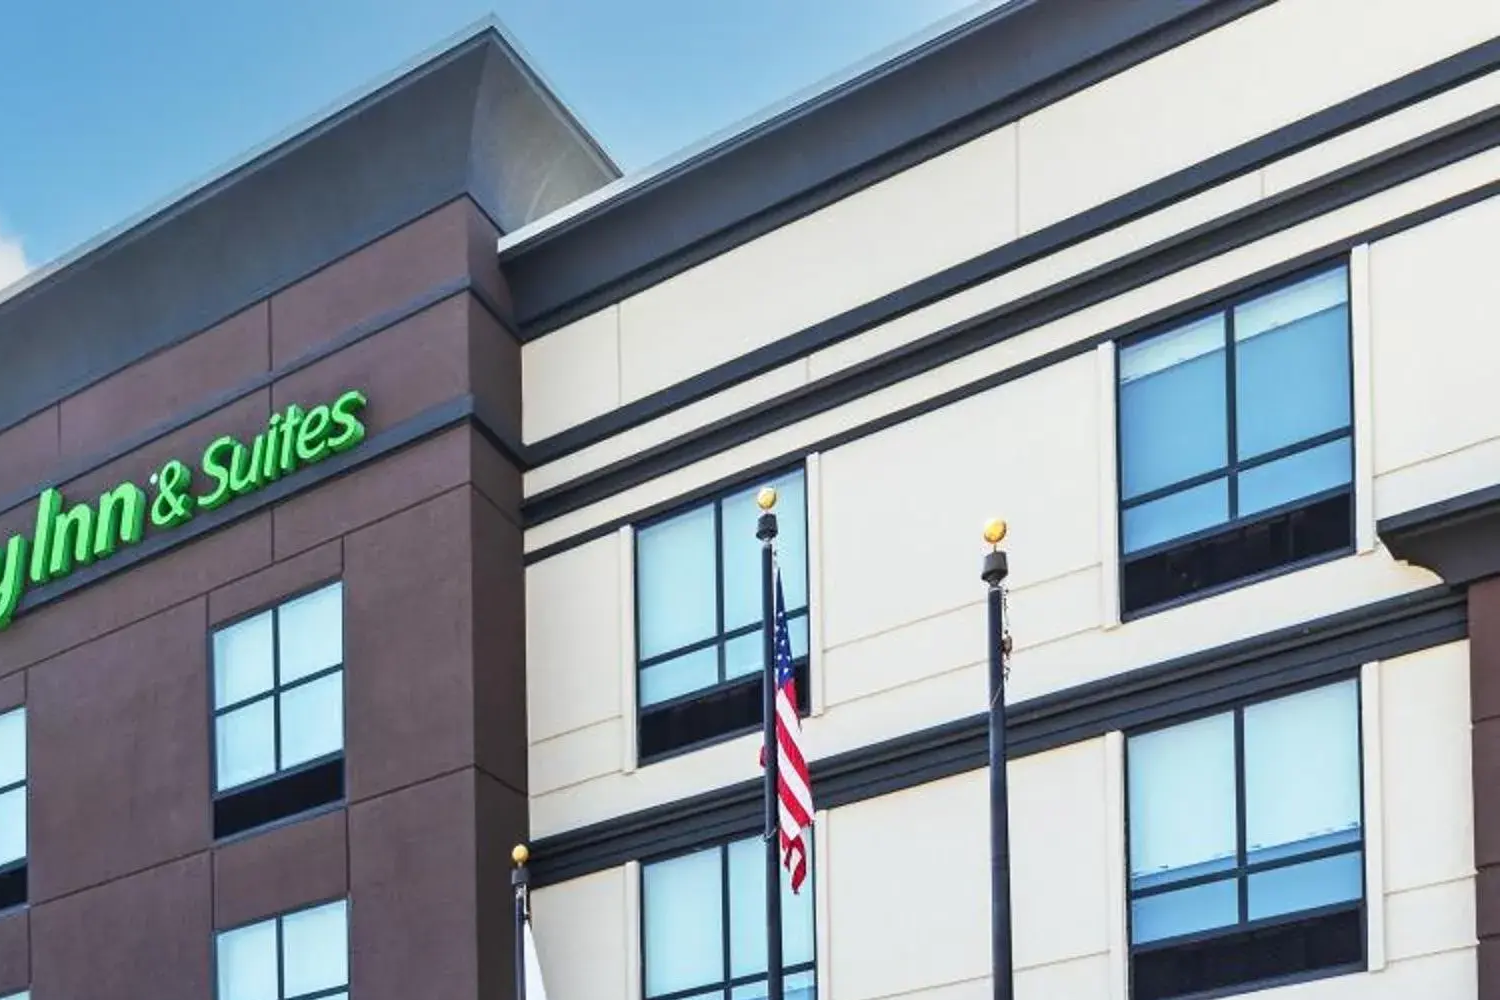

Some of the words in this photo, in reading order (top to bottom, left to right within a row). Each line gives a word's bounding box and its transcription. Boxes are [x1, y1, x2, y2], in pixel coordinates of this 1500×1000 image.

[32, 486, 148, 583] Inn
[151, 458, 192, 527] &
[197, 390, 368, 507] Suites
